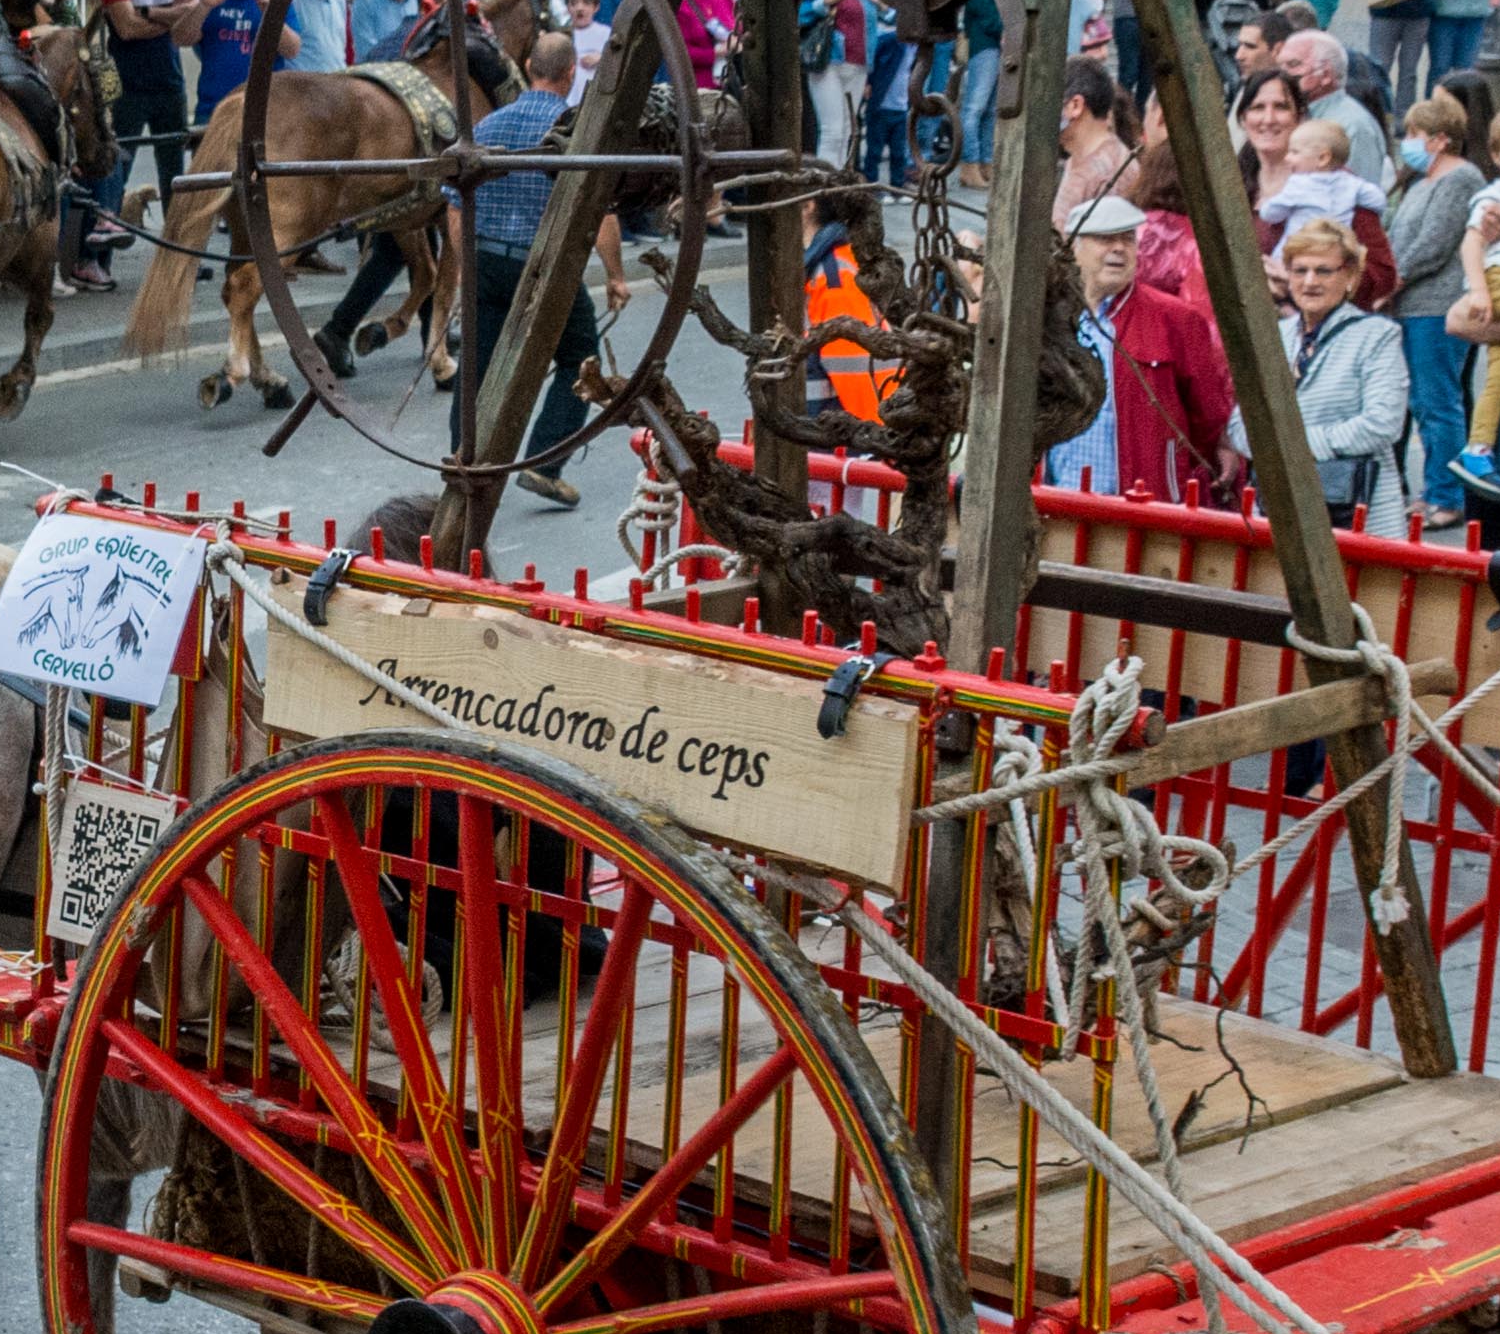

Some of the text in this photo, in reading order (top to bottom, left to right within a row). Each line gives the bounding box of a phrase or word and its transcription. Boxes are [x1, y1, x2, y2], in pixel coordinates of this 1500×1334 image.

[39, 534, 173, 585] GRUP EQÜESTRE
[33, 648, 114, 682] CERVELLÓ
[358, 658, 770, 801] Arrencadora de ceps
